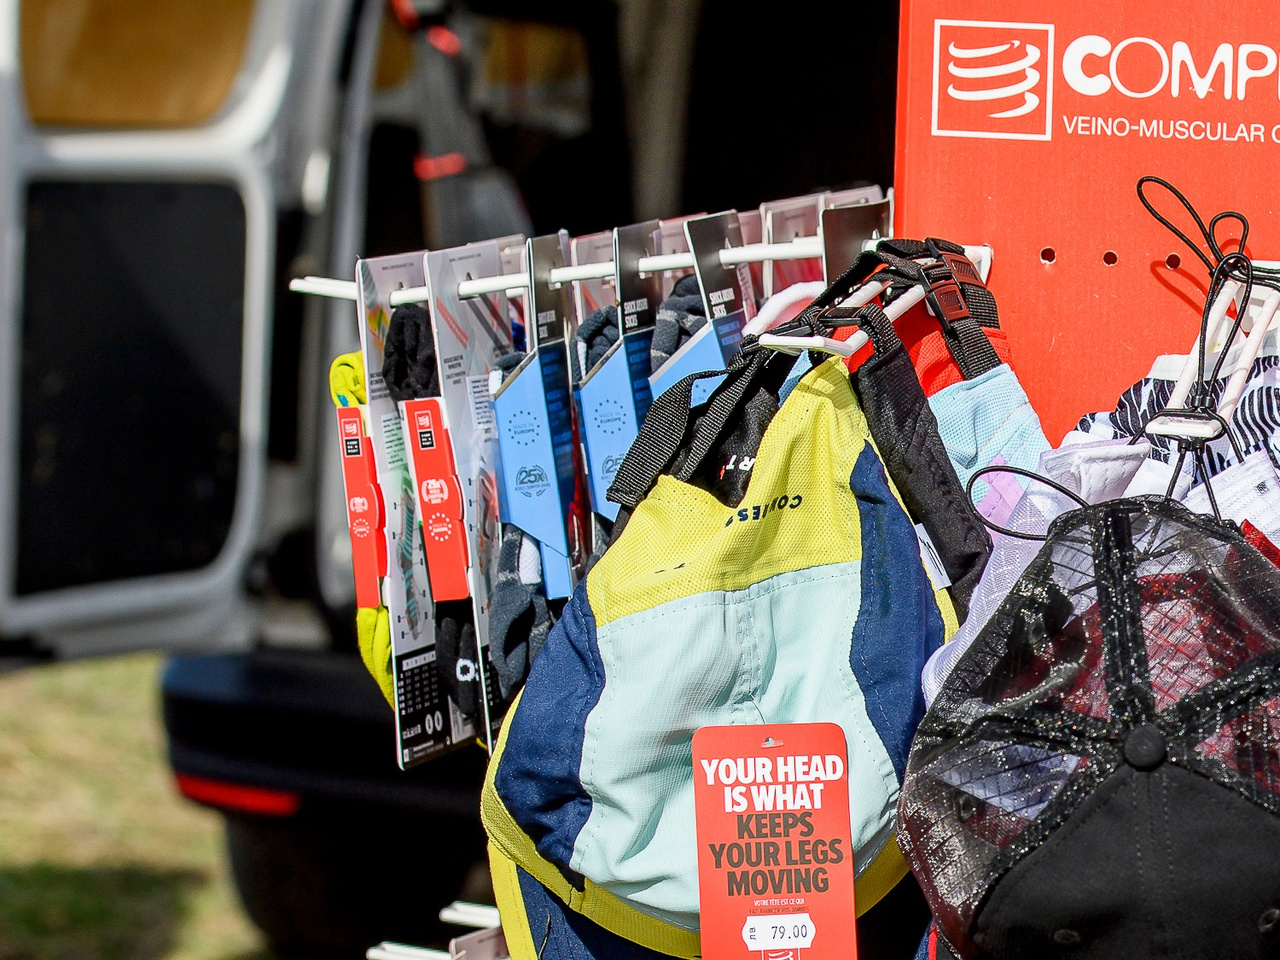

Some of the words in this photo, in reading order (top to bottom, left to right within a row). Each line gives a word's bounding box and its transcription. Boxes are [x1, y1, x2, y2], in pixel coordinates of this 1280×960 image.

[1062, 115, 1265, 143] VEINO-MUSCULAR
[701, 757, 773, 785] YOUR
[776, 755, 844, 782] HEAD
[724, 786, 748, 812] IS
[750, 783, 824, 811] WHAT
[737, 812, 815, 839] KEEPS
[709, 842, 780, 868] YOUR
[785, 839, 844, 865] LEGS
[727, 868, 829, 896] MOVING
[771, 924, 808, 940] 79.00
